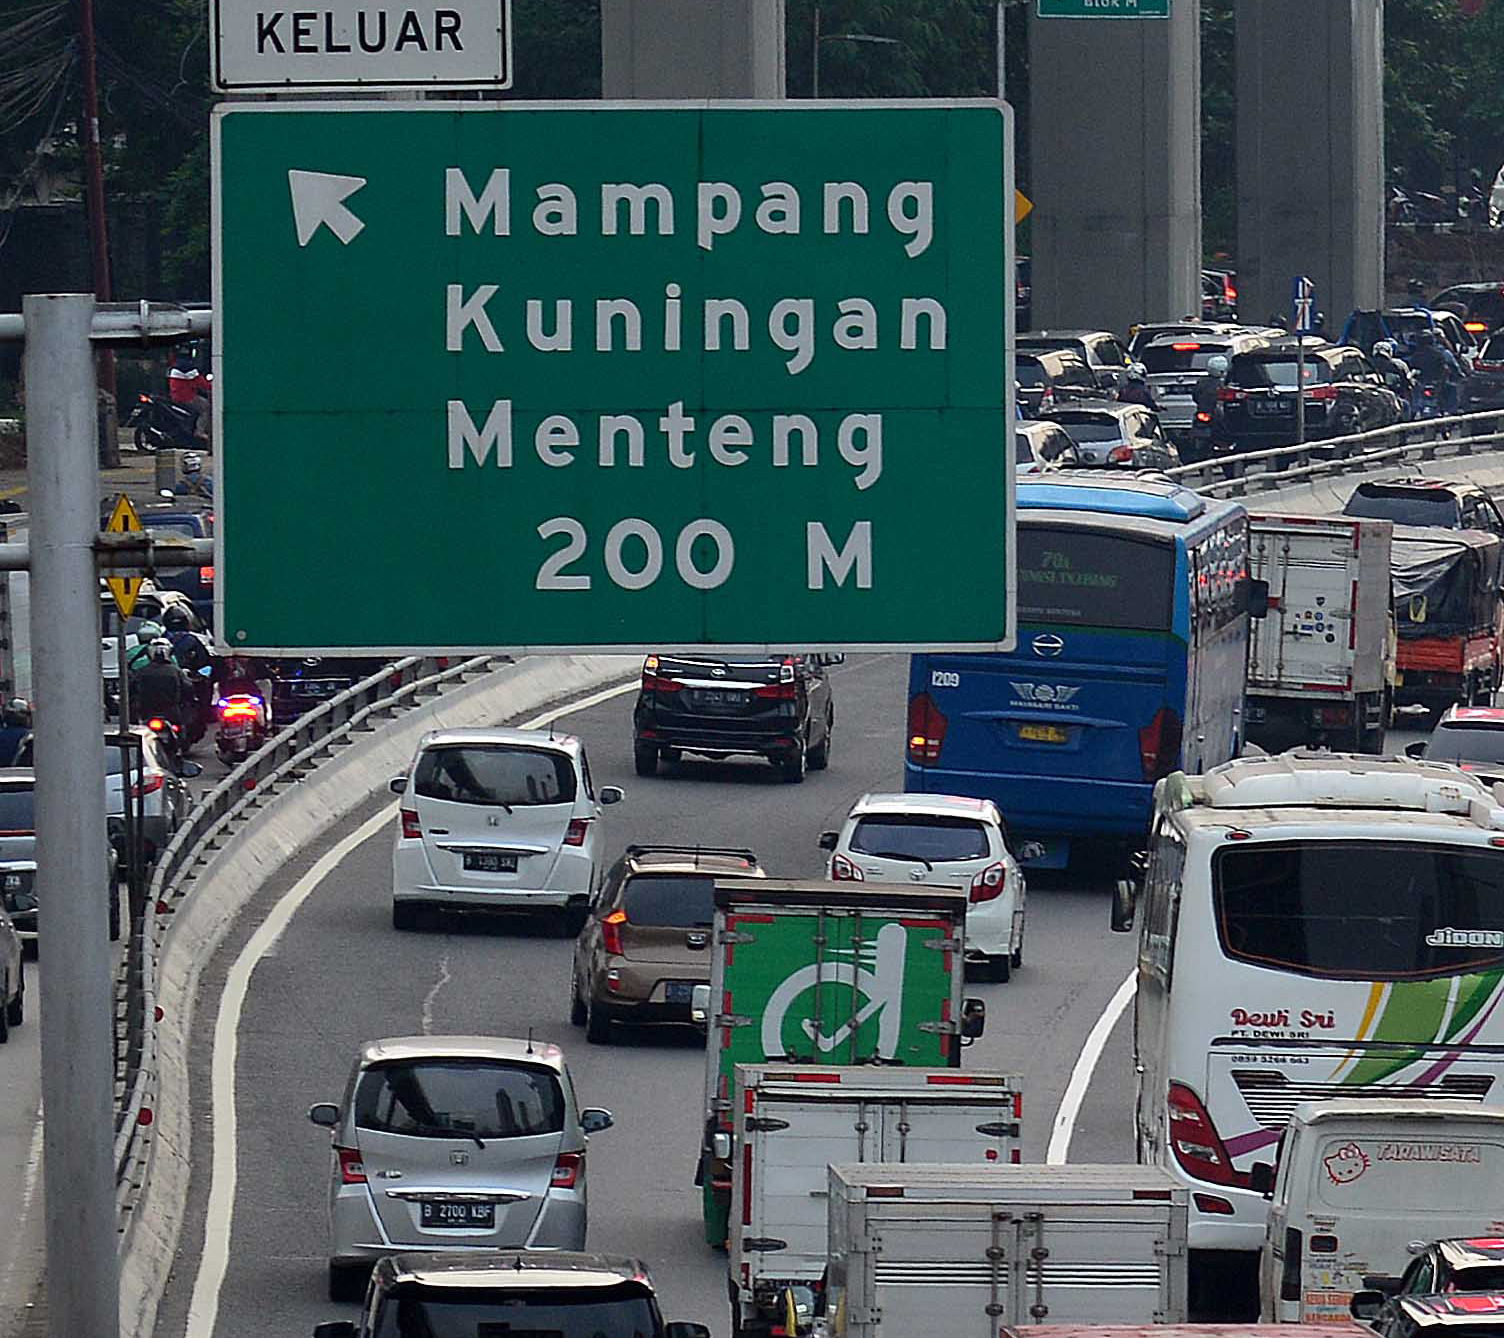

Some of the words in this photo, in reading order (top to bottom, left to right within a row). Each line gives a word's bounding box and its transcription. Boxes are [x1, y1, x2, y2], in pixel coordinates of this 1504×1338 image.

[255, 9, 465, 54] KELUAR
[444, 167, 934, 259] Mampang
[446, 282, 947, 375] Kuningan
[447, 398, 884, 491] Menteng
[536, 517, 736, 591] 200
[806, 520, 873, 591] M
[1253, 1031, 1285, 1039] DEWI
[424, 1205, 432, 1218] B
[439, 1205, 466, 1218] 2700
